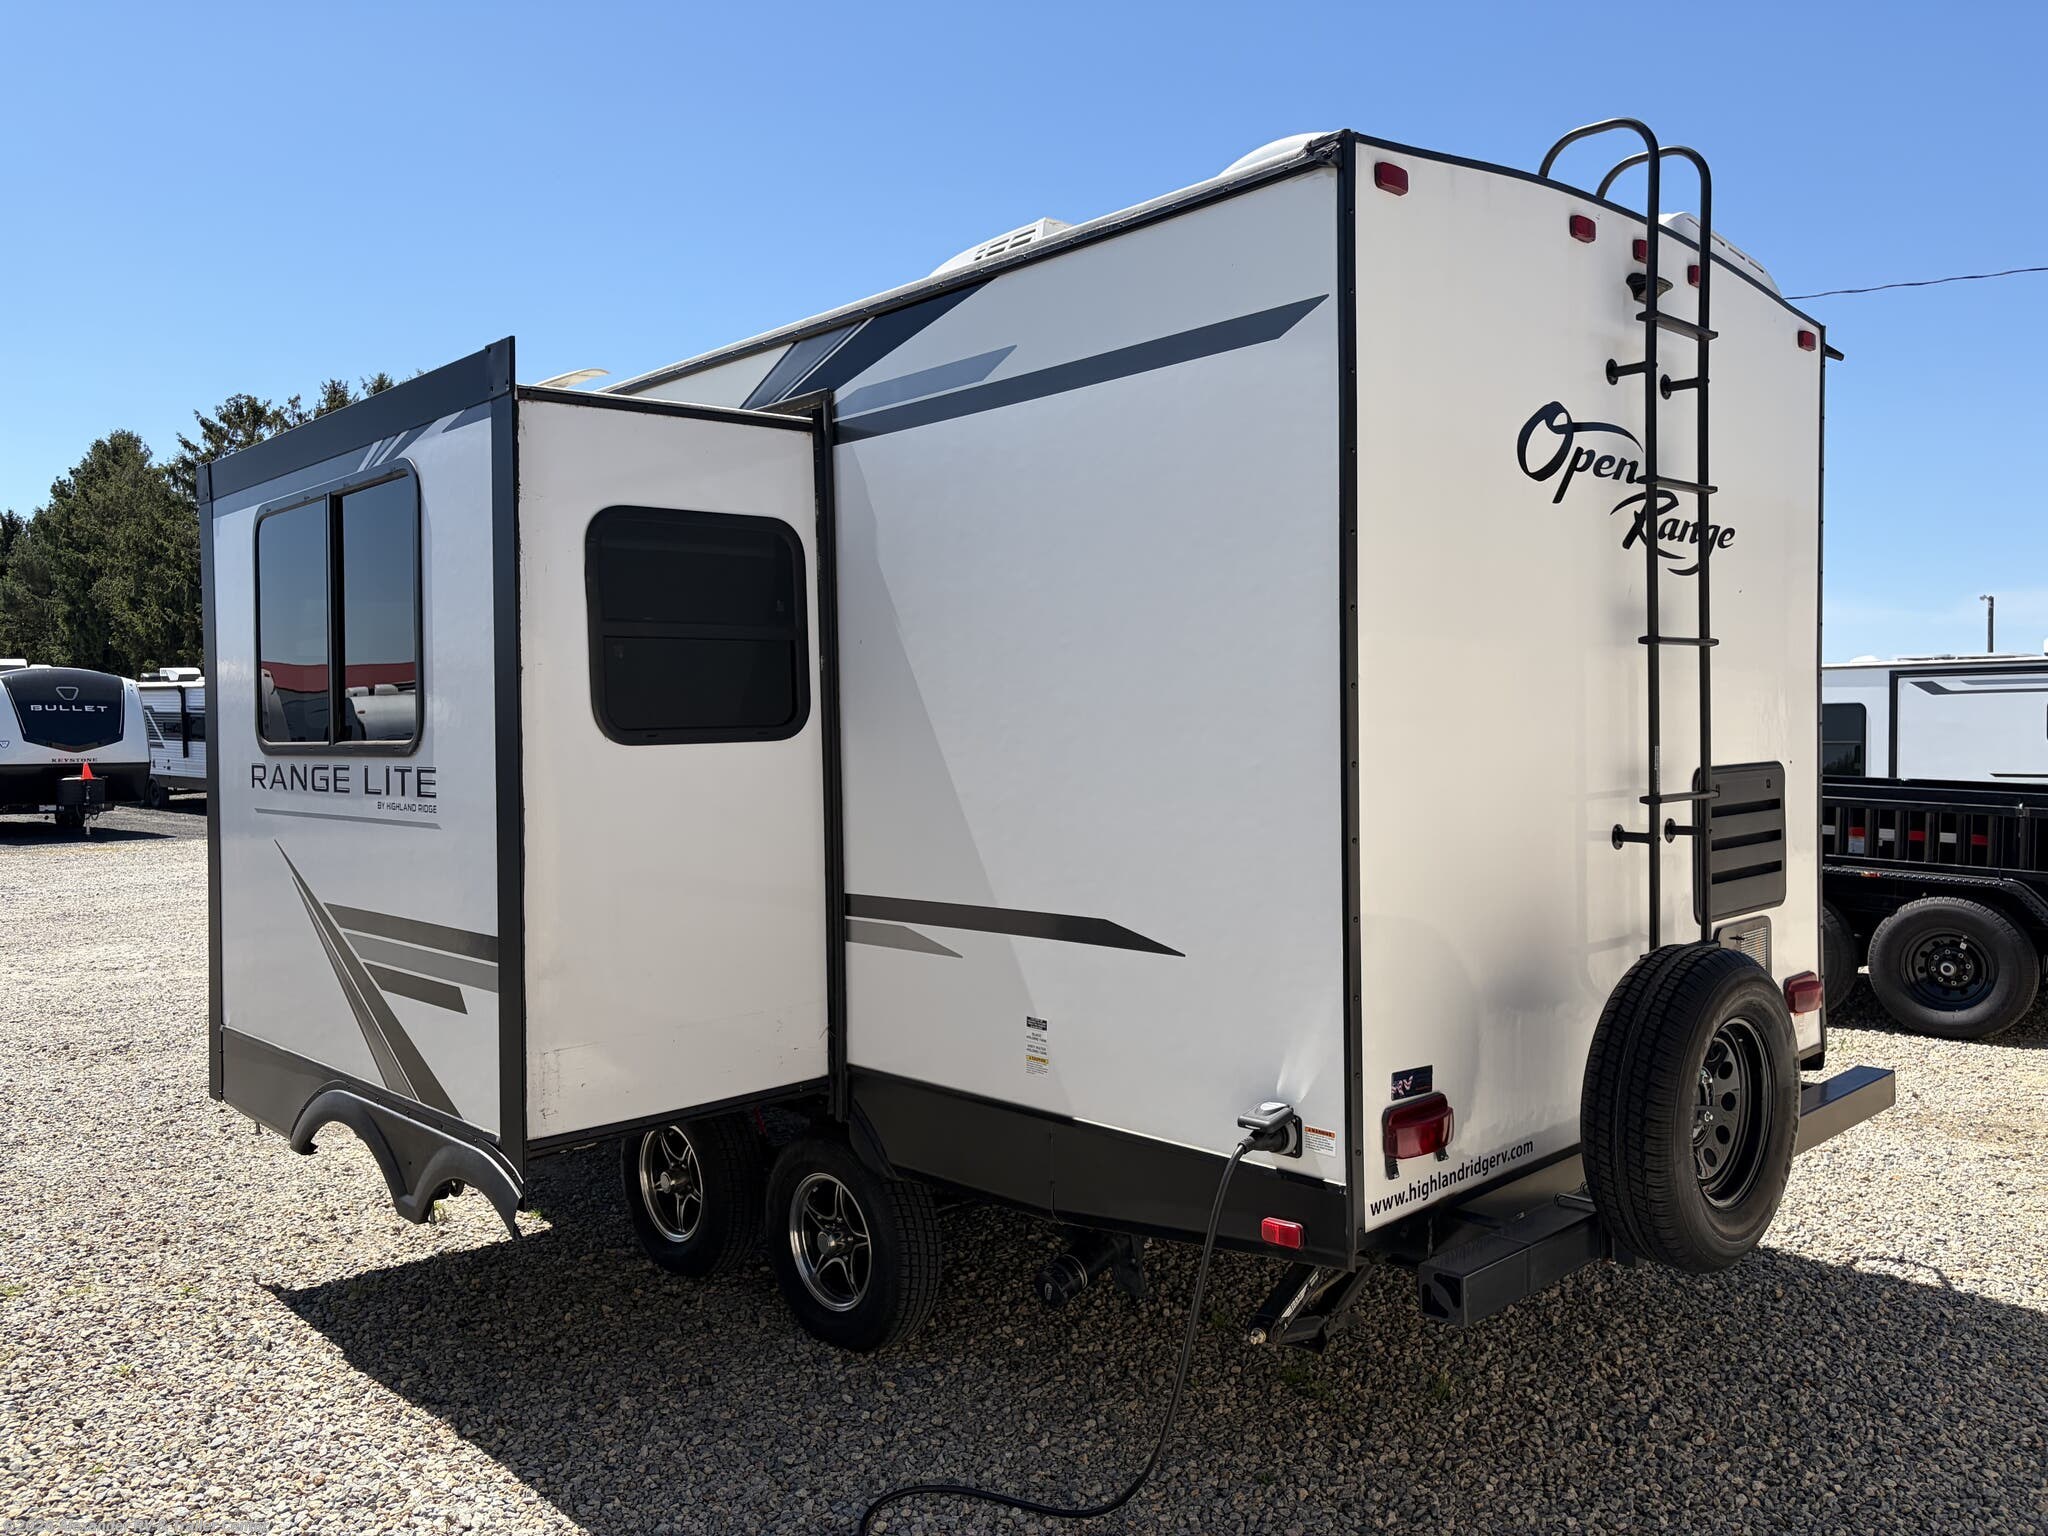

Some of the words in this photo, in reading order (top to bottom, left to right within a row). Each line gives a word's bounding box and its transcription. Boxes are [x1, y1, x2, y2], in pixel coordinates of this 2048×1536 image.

[1517, 401, 1644, 503] Open
[1610, 489, 1736, 576] Range
[30, 704, 108, 712] BULLET
[251, 763, 350, 794] RANGE
[364, 765, 437, 799] LITE
[377, 801, 385, 810] BY
[386, 802, 417, 813] HIGHLAND
[418, 803, 437, 814] RIDGE
[1370, 1139, 1534, 1217] www.highlandridgerv.com
